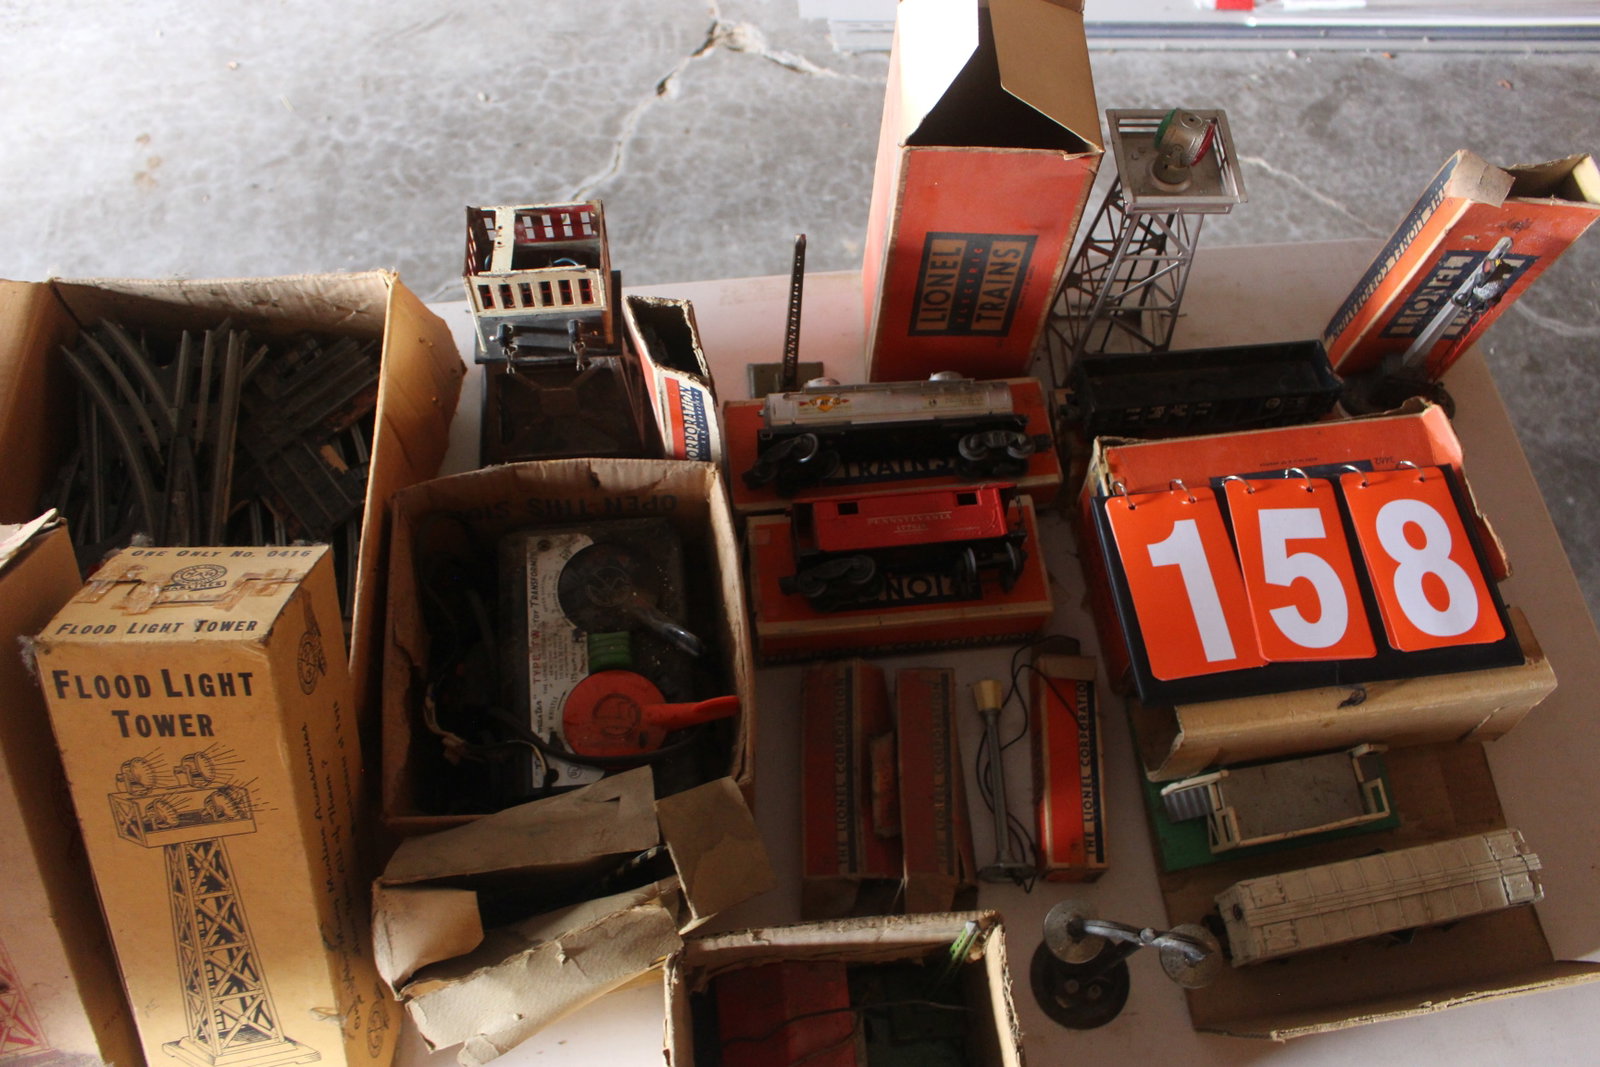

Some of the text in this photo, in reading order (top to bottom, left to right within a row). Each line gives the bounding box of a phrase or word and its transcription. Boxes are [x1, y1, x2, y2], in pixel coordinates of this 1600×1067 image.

[1394, 213, 1427, 263] LIONEL
[919, 246, 962, 324] LIONEL
[975, 246, 1022, 323] TRAINS
[1396, 258, 1472, 331] LIONEL
[680, 383, 700, 461] ORPORATION
[131, 549, 168, 557] ONE
[175, 549, 222, 558] ONLY
[54, 618, 259, 635] FLOOD LIGHT TOWER
[51, 667, 255, 699] FLOOD LIGHT
[532, 654, 541, 684] TYPE
[111, 709, 215, 738] TOWER
[833, 679, 848, 865] THE LIONEL CORPORATION
[1081, 774, 1094, 824] LIONEL
[1085, 836, 1095, 855] THE
